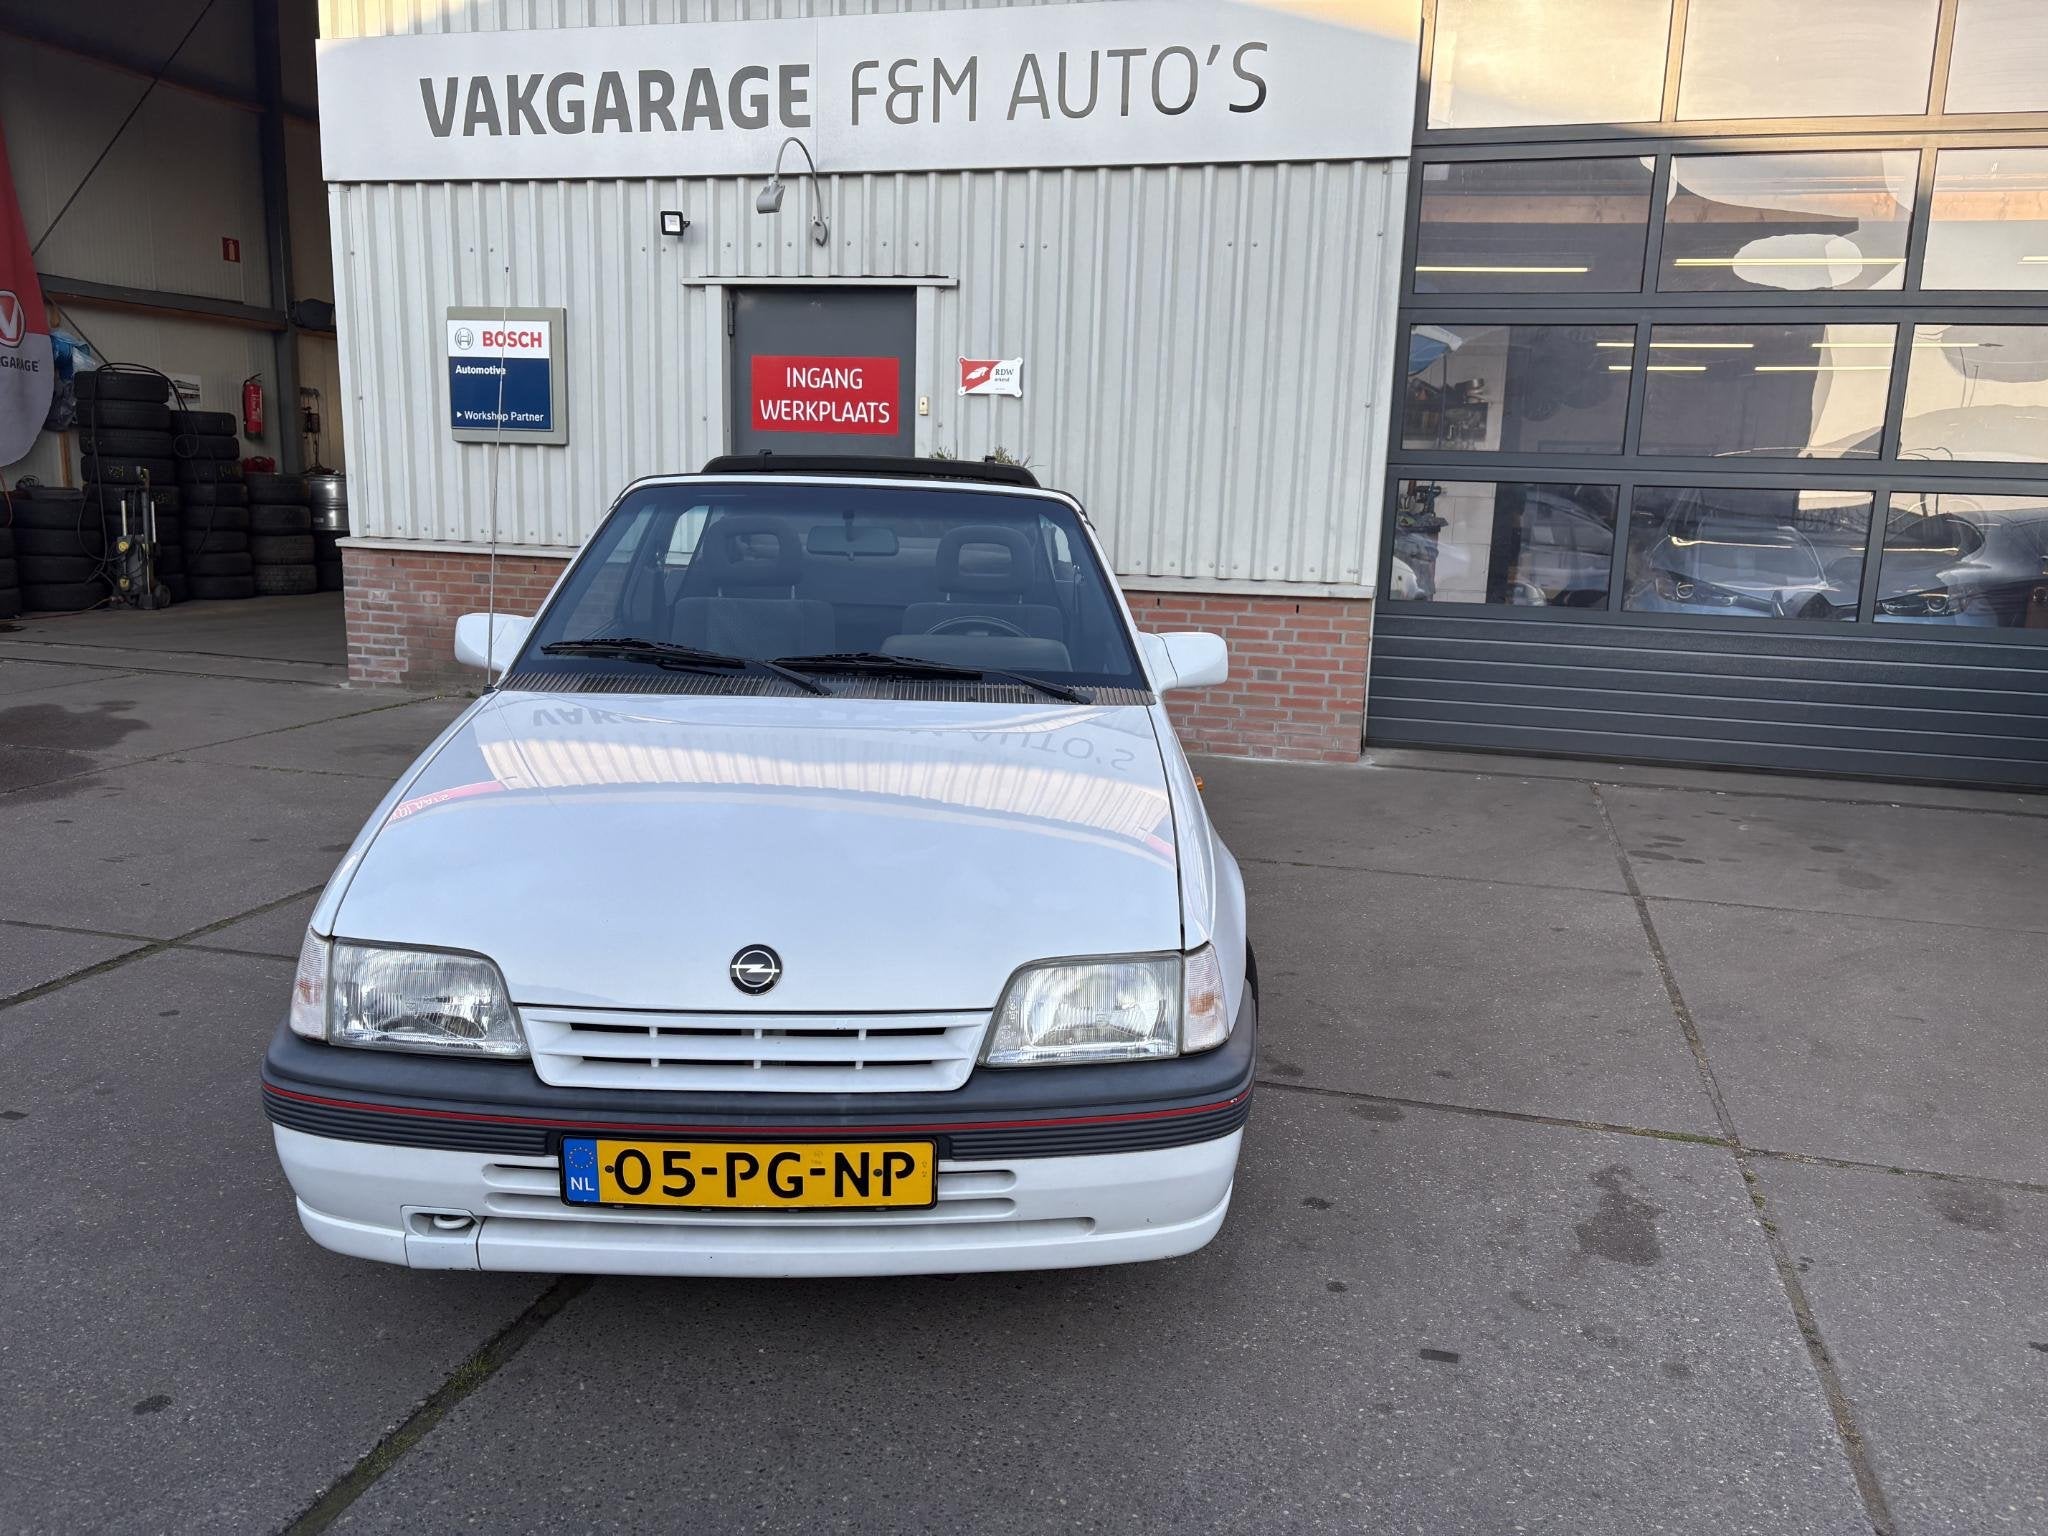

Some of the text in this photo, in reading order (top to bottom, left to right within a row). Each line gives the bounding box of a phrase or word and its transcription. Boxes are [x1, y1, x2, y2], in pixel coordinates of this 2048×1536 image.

[419, 41, 1269, 138] VAKGARAGE F&M AUTO'S
[482, 331, 543, 348] BOSCH
[455, 365, 507, 375] Automotive
[787, 367, 863, 389] INGANG
[464, 411, 544, 422] Workshop Partner
[760, 400, 890, 423] WERKPLAATS
[613, 1149, 916, 1198] 05-PG-NP
[570, 1177, 595, 1192] NL
